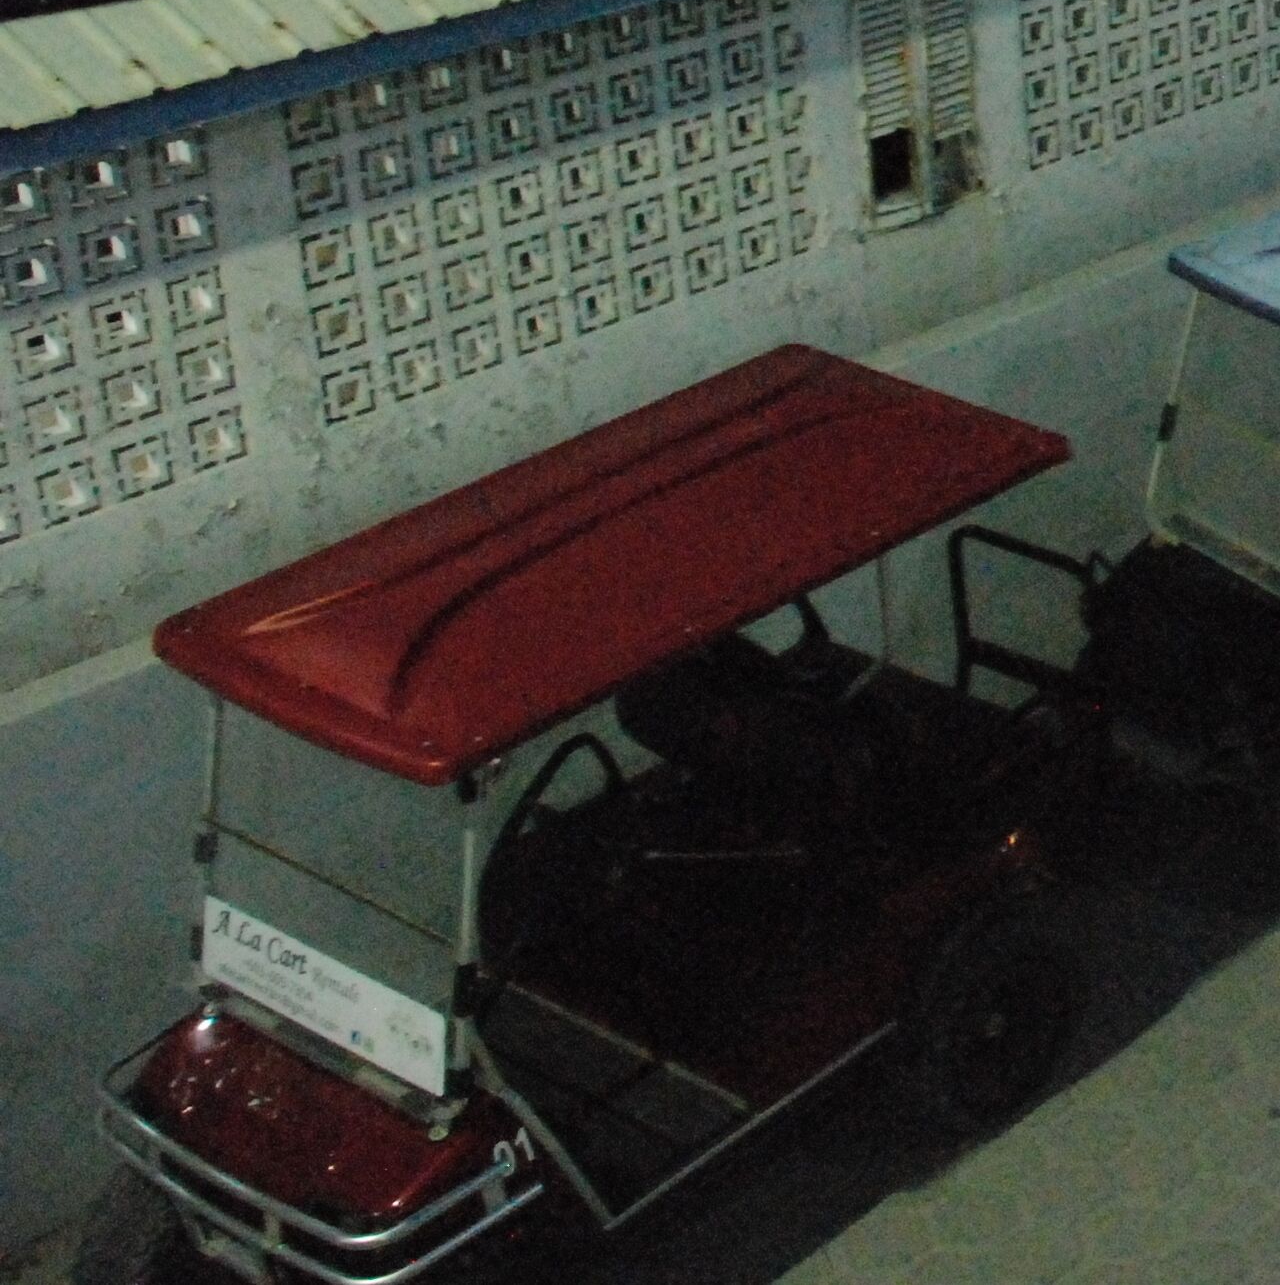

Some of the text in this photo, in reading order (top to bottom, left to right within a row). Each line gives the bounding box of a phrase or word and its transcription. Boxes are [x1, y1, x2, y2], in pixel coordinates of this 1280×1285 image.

[212, 910, 231, 937] A
[235, 921, 261, 953] La
[267, 937, 308, 975] Cart
